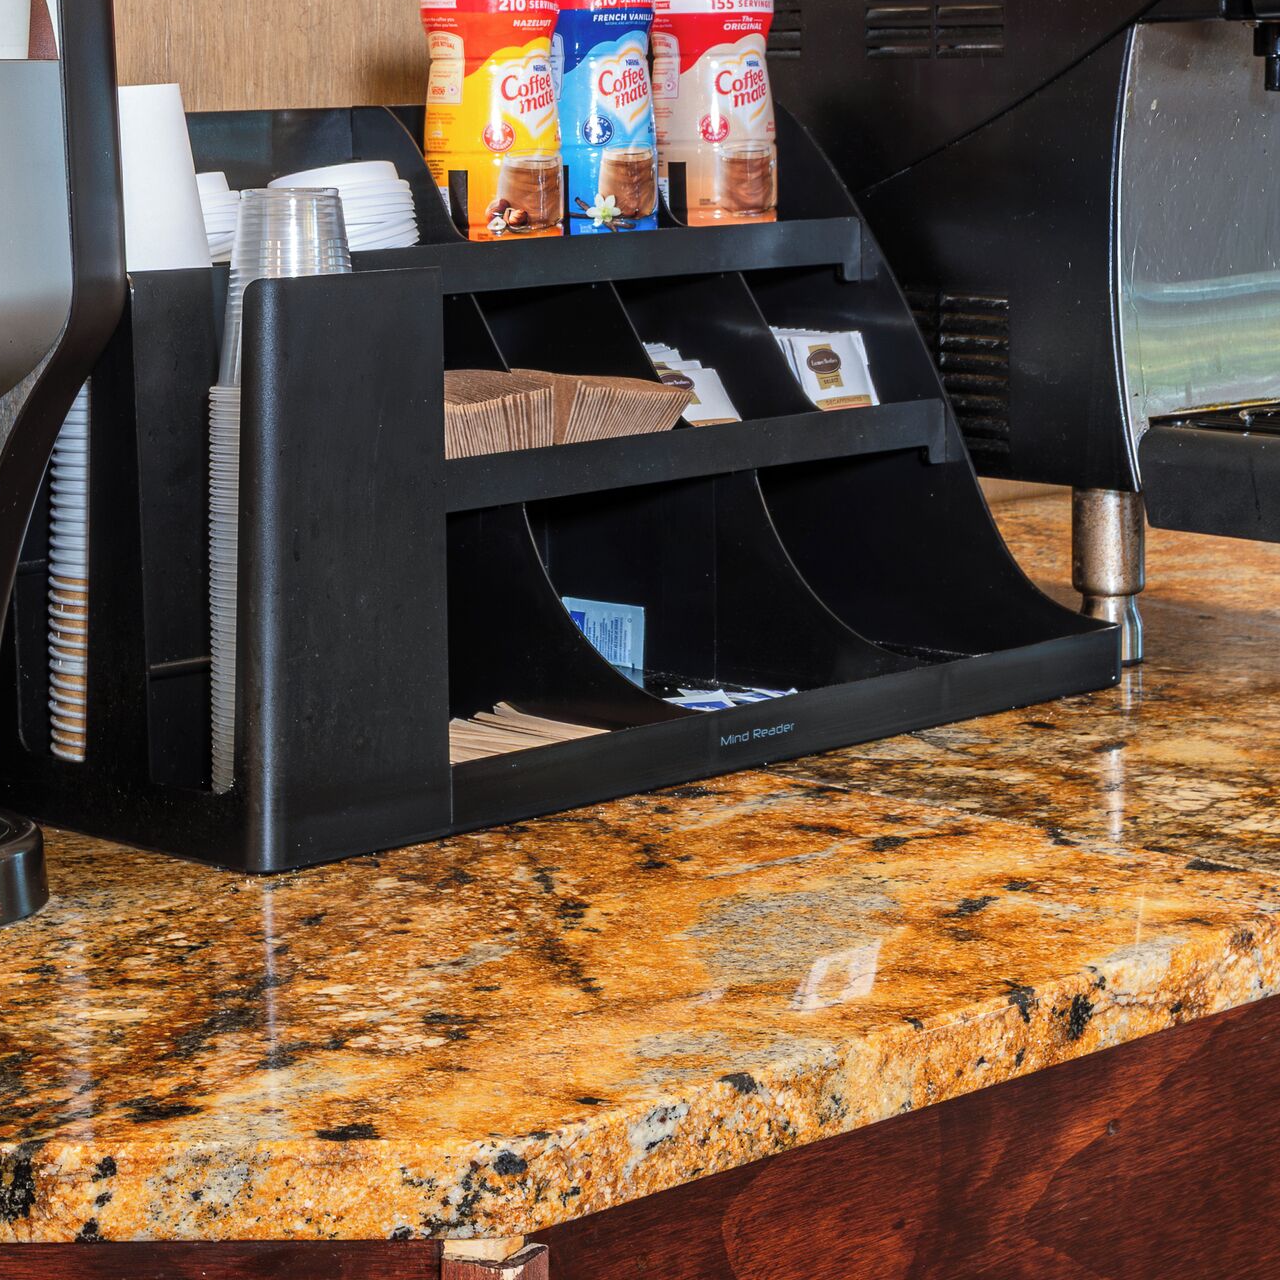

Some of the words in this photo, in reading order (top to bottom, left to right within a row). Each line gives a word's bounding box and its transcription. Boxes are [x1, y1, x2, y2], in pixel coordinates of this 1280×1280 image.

[512, 19, 552, 27] HAZELNUT
[593, 14, 627, 22] FRENCH
[723, 23, 762, 31] ORIGINAL
[501, 73, 551, 100] Coffee
[598, 66, 644, 96] Coffee
[715, 67, 764, 96] Coffee
[520, 90, 554, 114] mate
[615, 80, 649, 109] mate
[733, 83, 766, 108] mate
[720, 731, 750, 747] Mind
[753, 722, 795, 739] Reader
